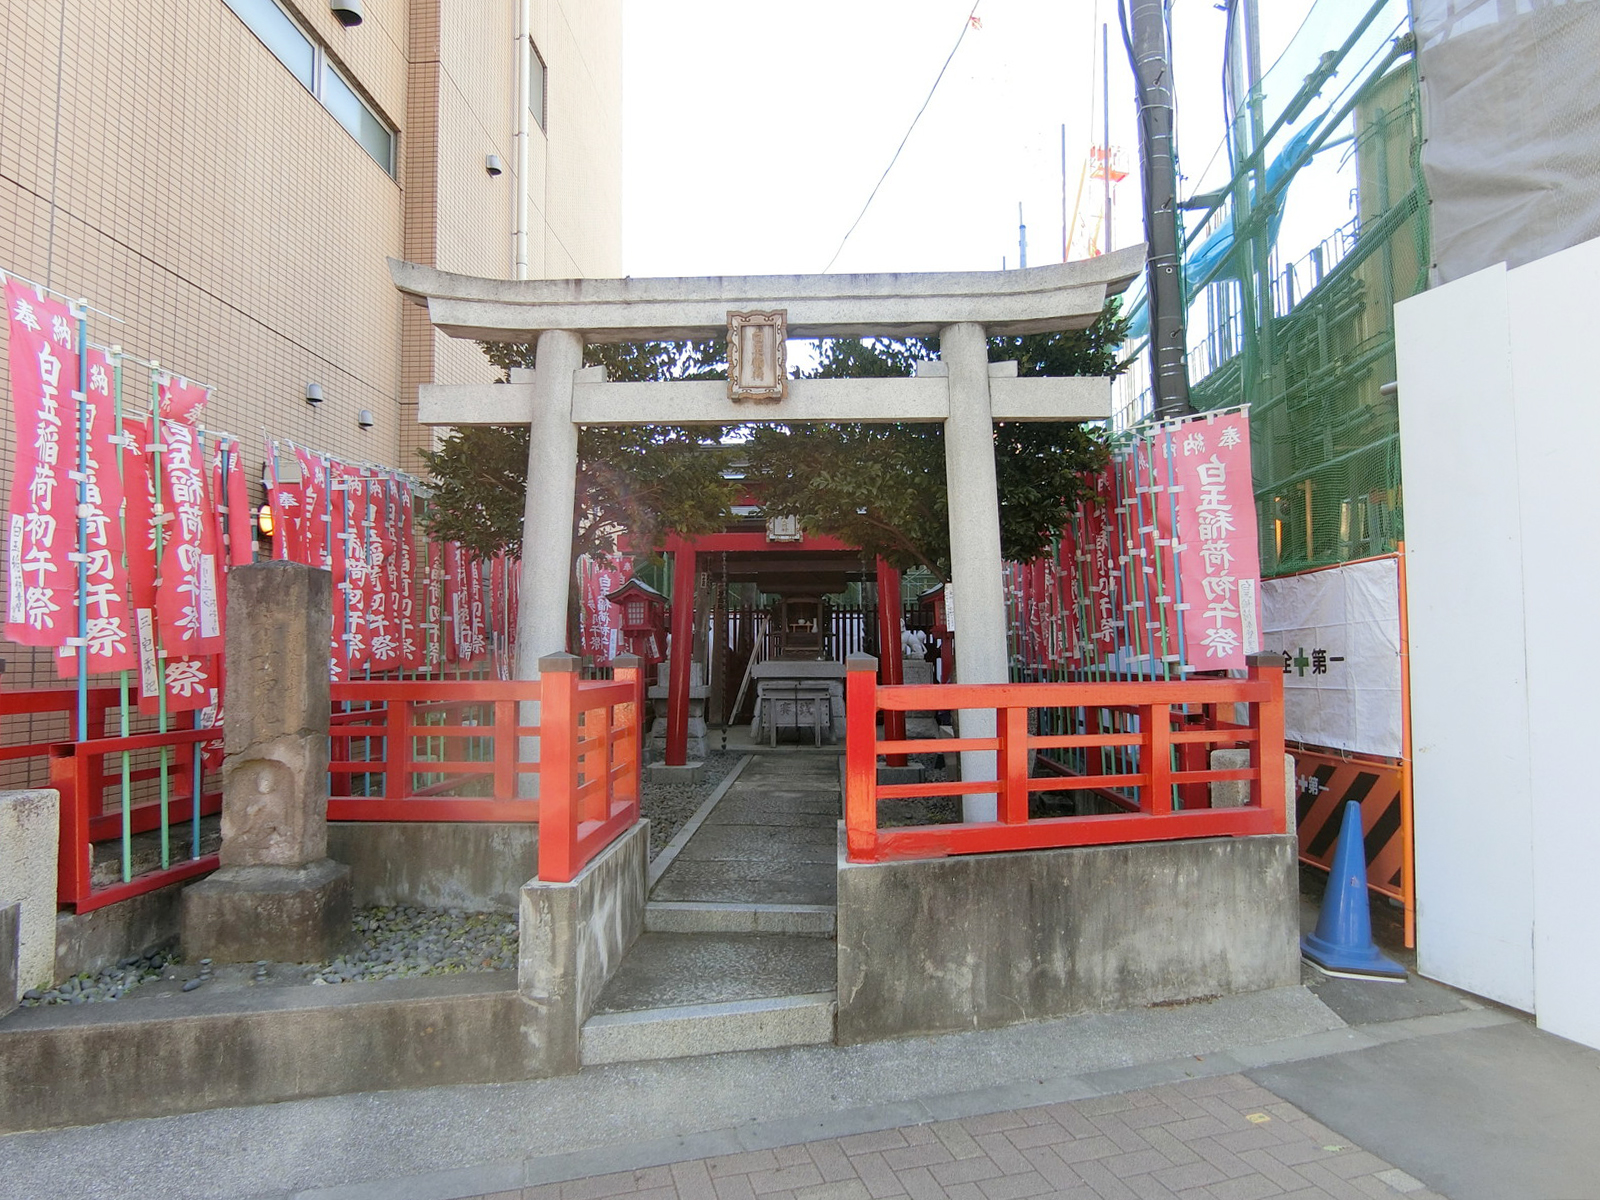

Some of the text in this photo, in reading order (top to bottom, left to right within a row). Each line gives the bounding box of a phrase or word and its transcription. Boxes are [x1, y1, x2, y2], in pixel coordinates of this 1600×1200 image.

[13, 298, 72, 350] 奉納
[89, 364, 109, 397] 納
[22, 341, 62, 631] 白玉稲荷初午祭
[278, 491, 300, 509] 奉
[1311, 648, 1345, 675] 第一
